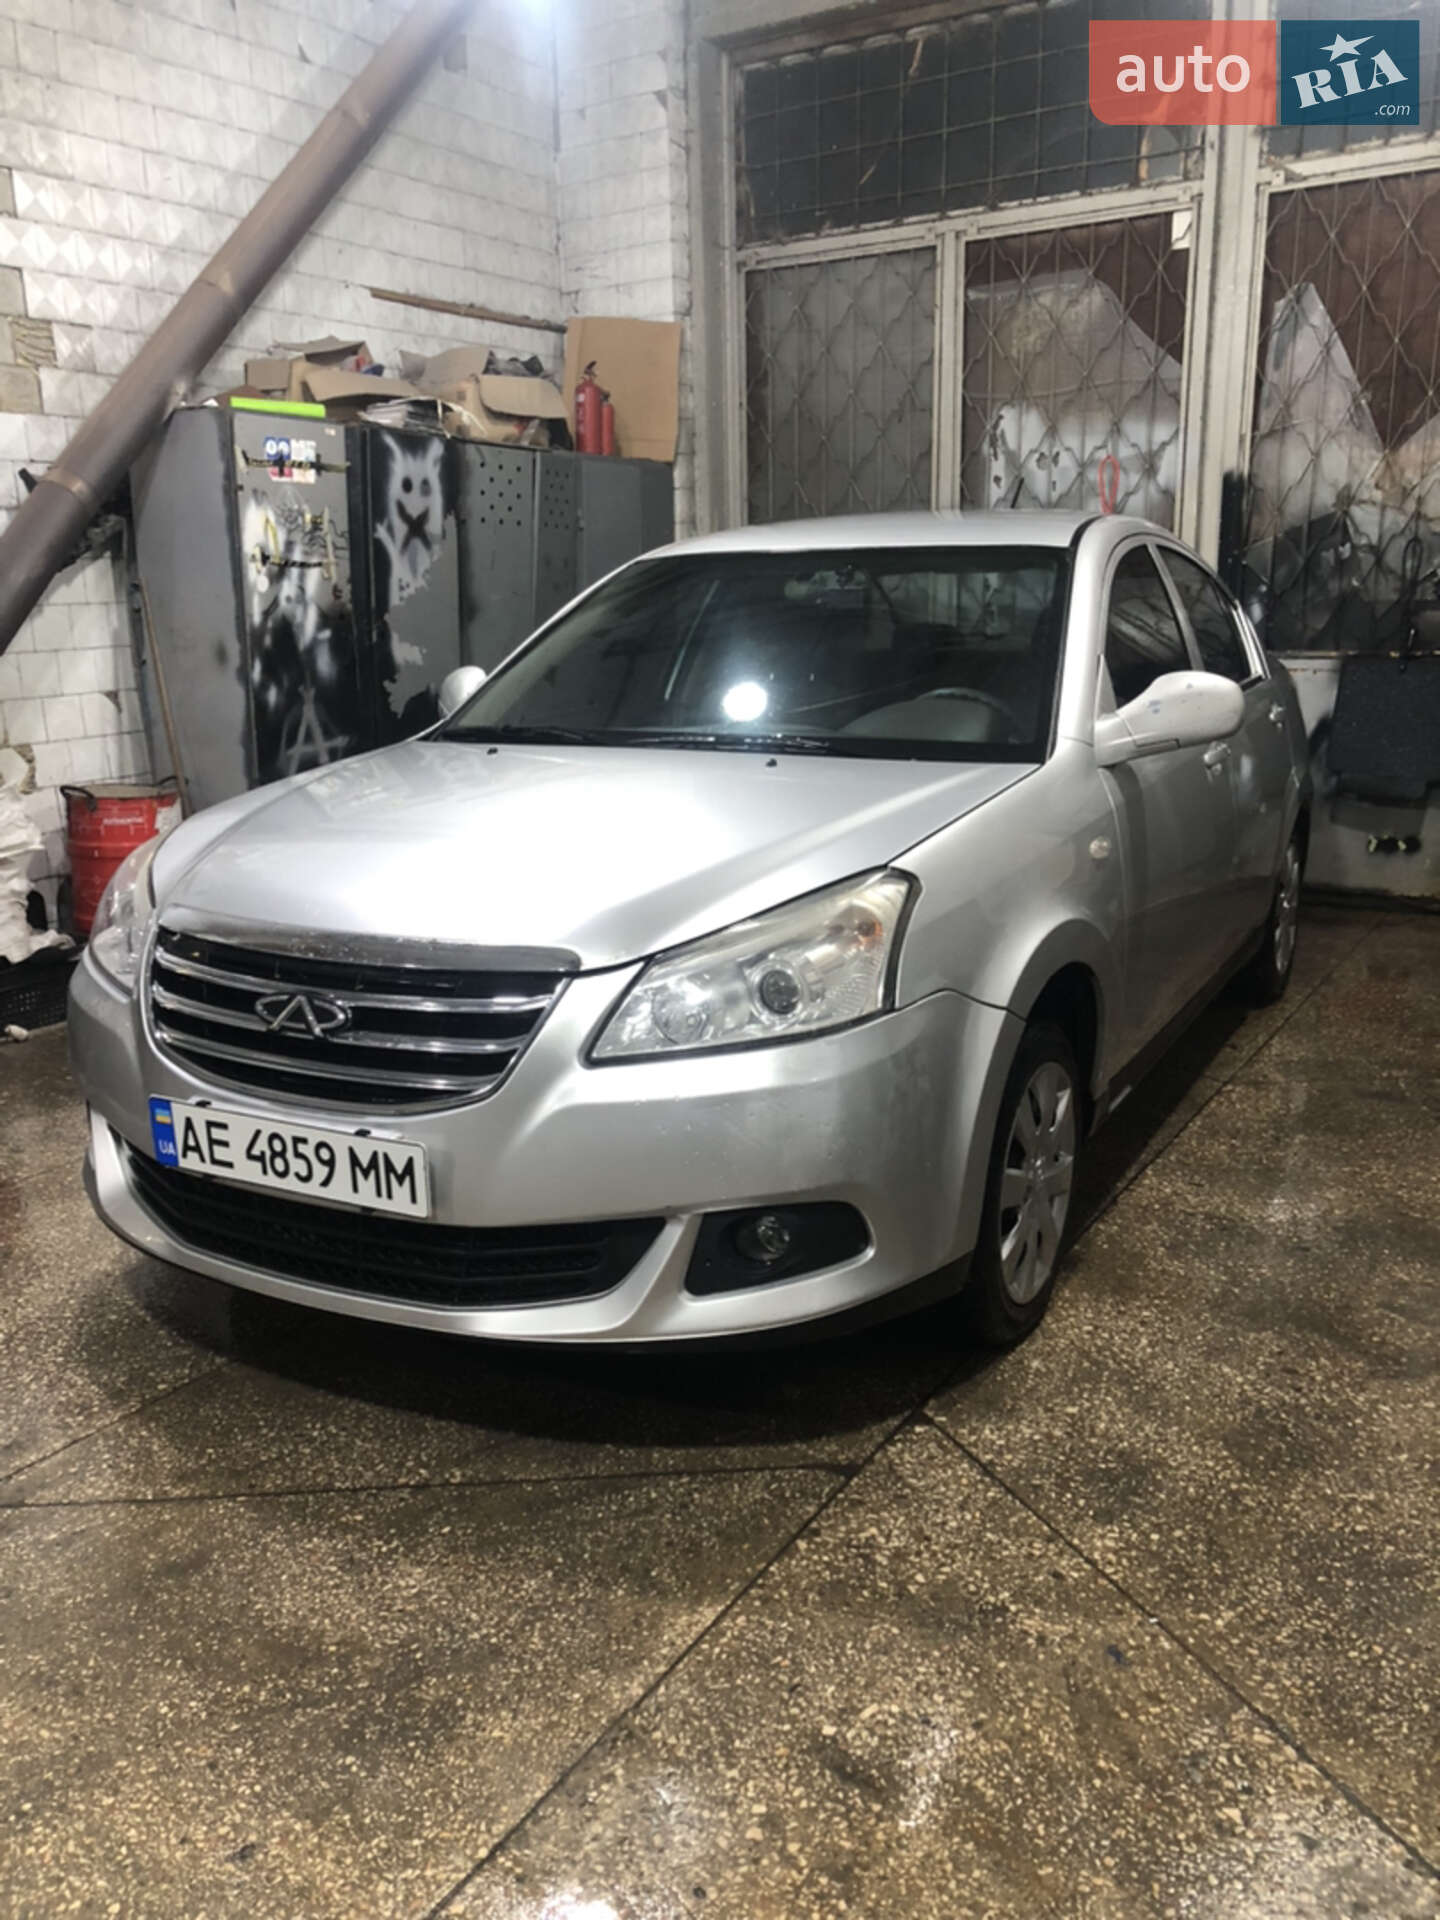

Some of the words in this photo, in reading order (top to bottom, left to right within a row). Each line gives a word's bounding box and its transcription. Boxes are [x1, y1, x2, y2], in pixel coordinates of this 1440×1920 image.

[158, 1139, 176, 1156] UA
[182, 1116, 234, 1169] AE
[246, 1129, 336, 1188] 4859
[348, 1145, 417, 1204] MM
